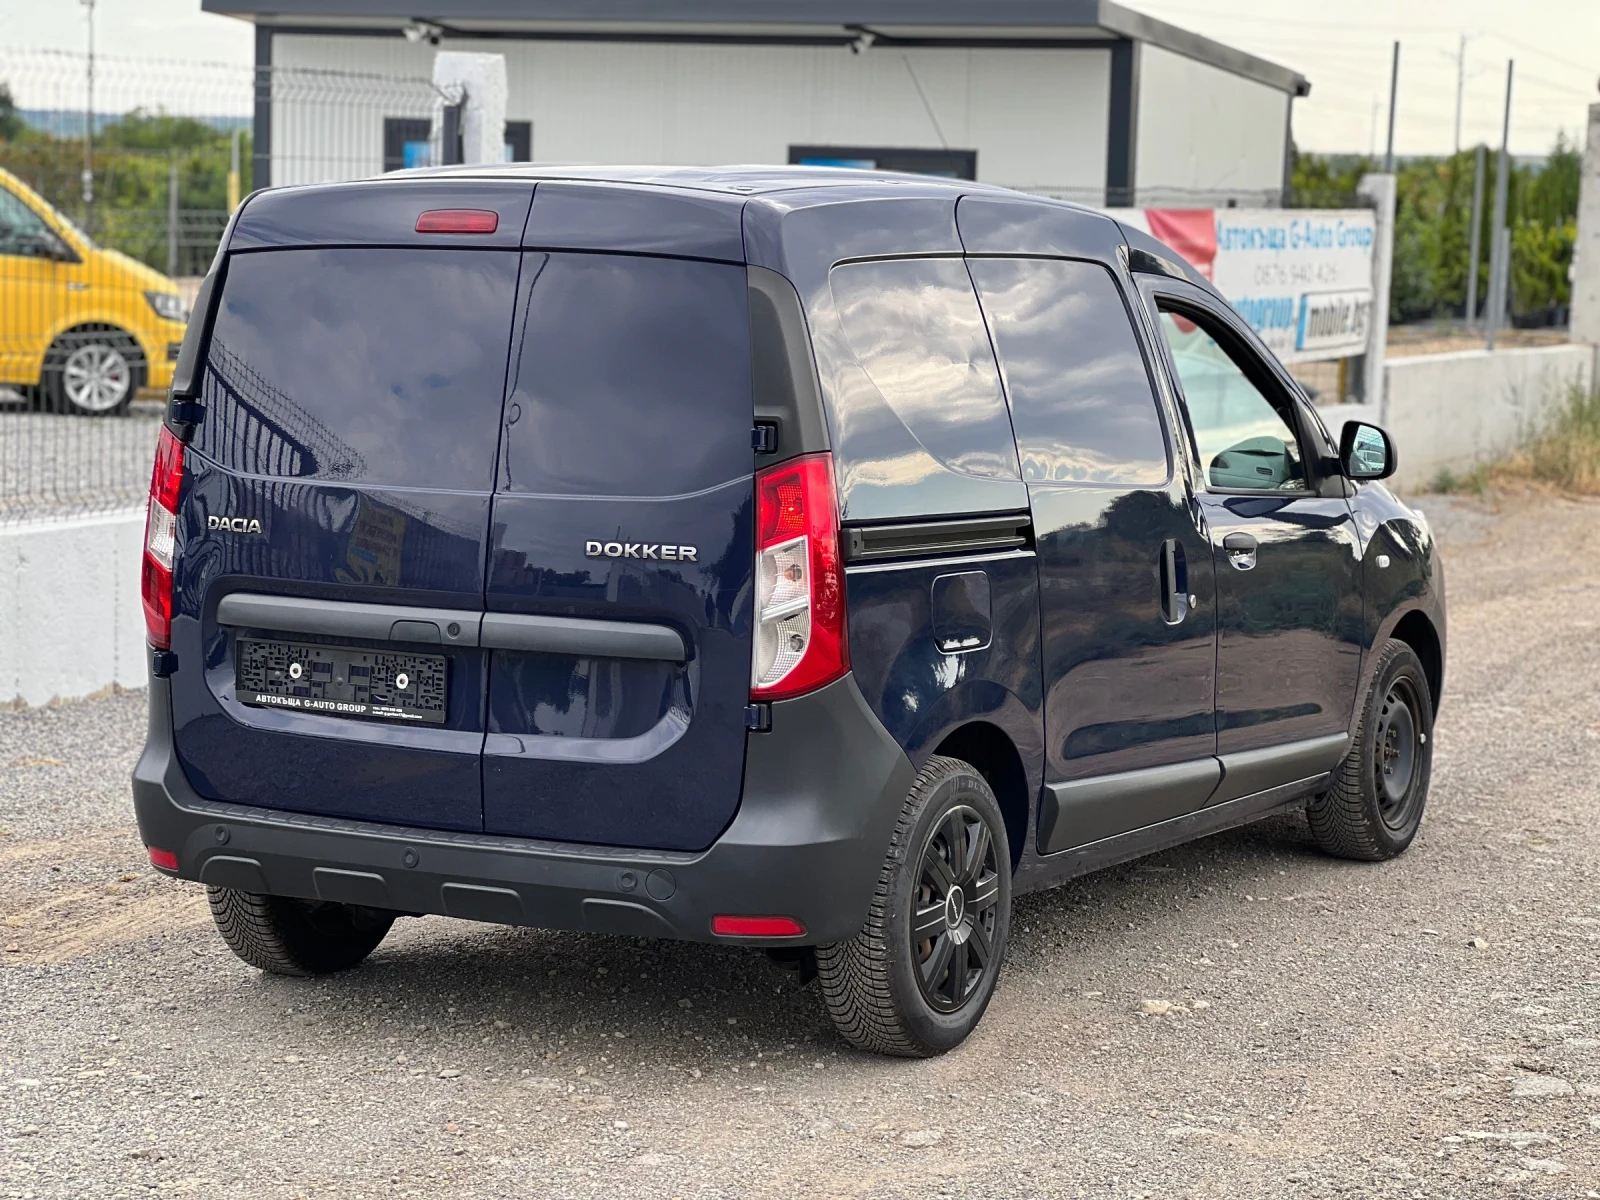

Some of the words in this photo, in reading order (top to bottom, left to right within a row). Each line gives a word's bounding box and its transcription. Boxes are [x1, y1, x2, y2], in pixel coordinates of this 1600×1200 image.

[1290, 219, 1332, 249] G-Auto
[1336, 220, 1374, 252] Group
[208, 515, 262, 534] DACIA
[586, 541, 698, 562] DOKKER
[255, 694, 301, 707] АВТОКЪЩА
[304, 699, 336, 710] G-AUTO
[337, 702, 367, 713] GROUP
